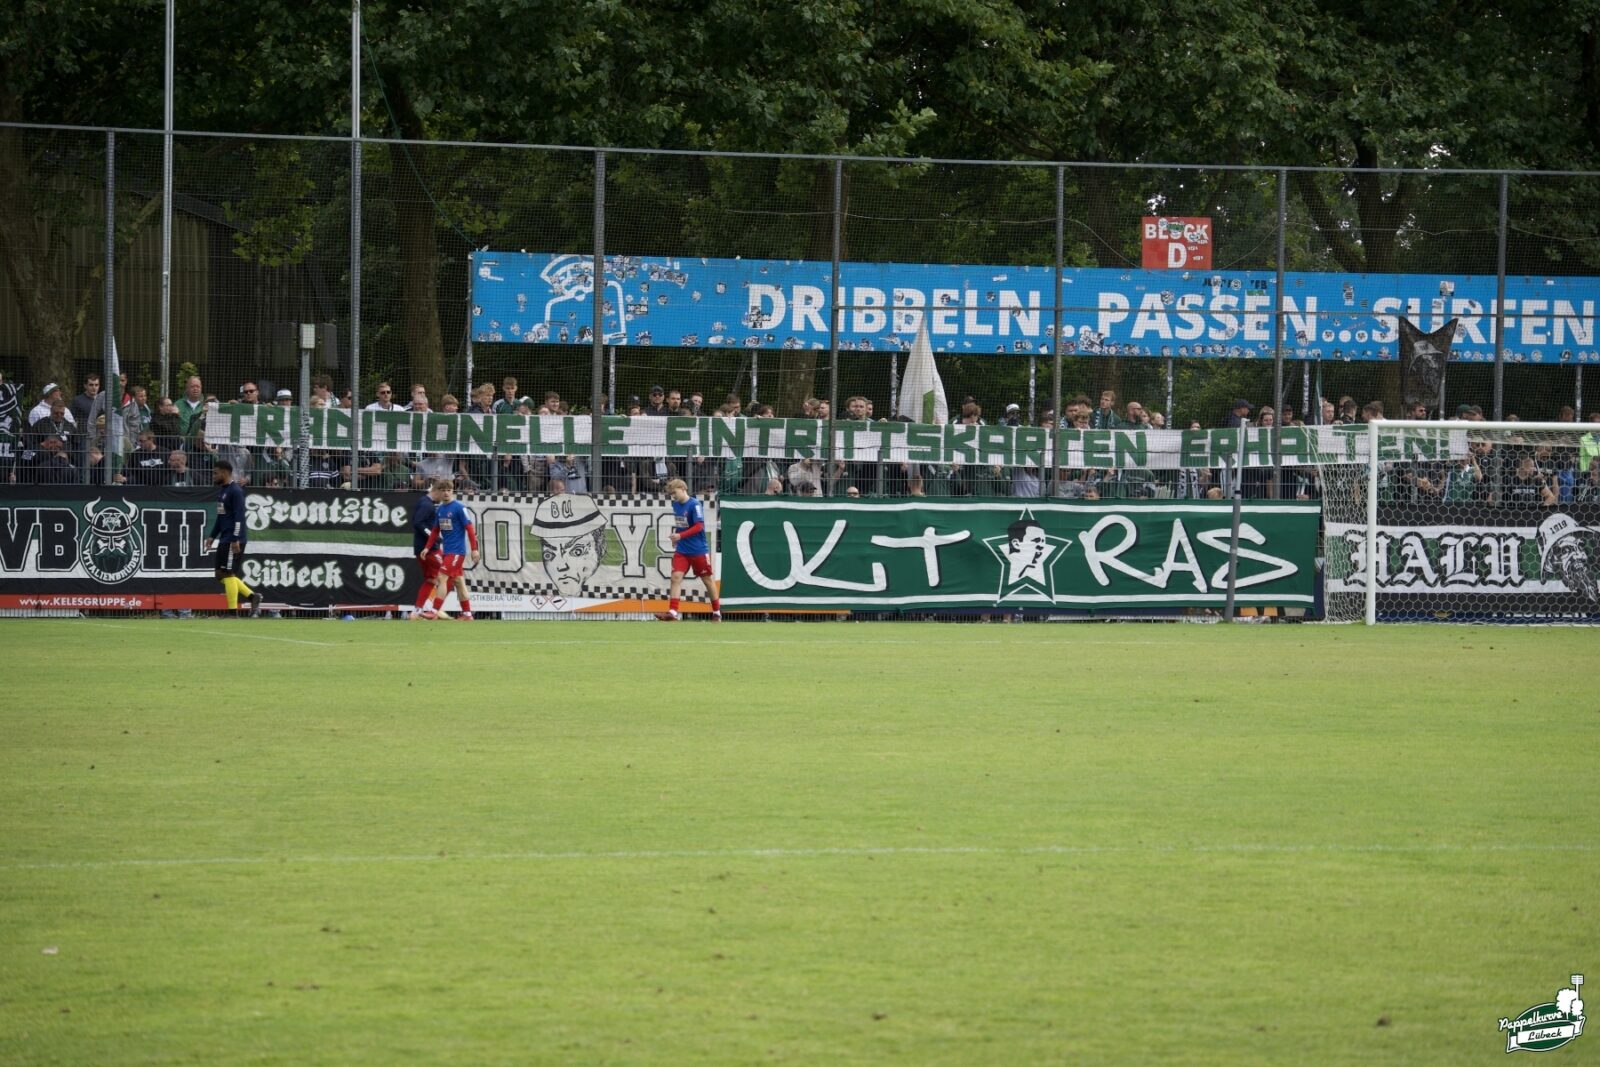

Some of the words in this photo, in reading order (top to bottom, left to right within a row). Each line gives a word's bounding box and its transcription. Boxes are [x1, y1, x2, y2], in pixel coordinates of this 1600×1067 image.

[1167, 242, 1188, 268] D
[217, 403, 631, 456] TRADITIONELLE
[666, 416, 1147, 468] EINTRITTSKARTEN
[0, 507, 79, 572] VB
[141, 508, 217, 572] HL
[82, 548, 140, 582] VITALIENBRÜDER
[242, 559, 344, 589] Lübeck
[19, 597, 142, 608] www.KELESGRUPPE.de
